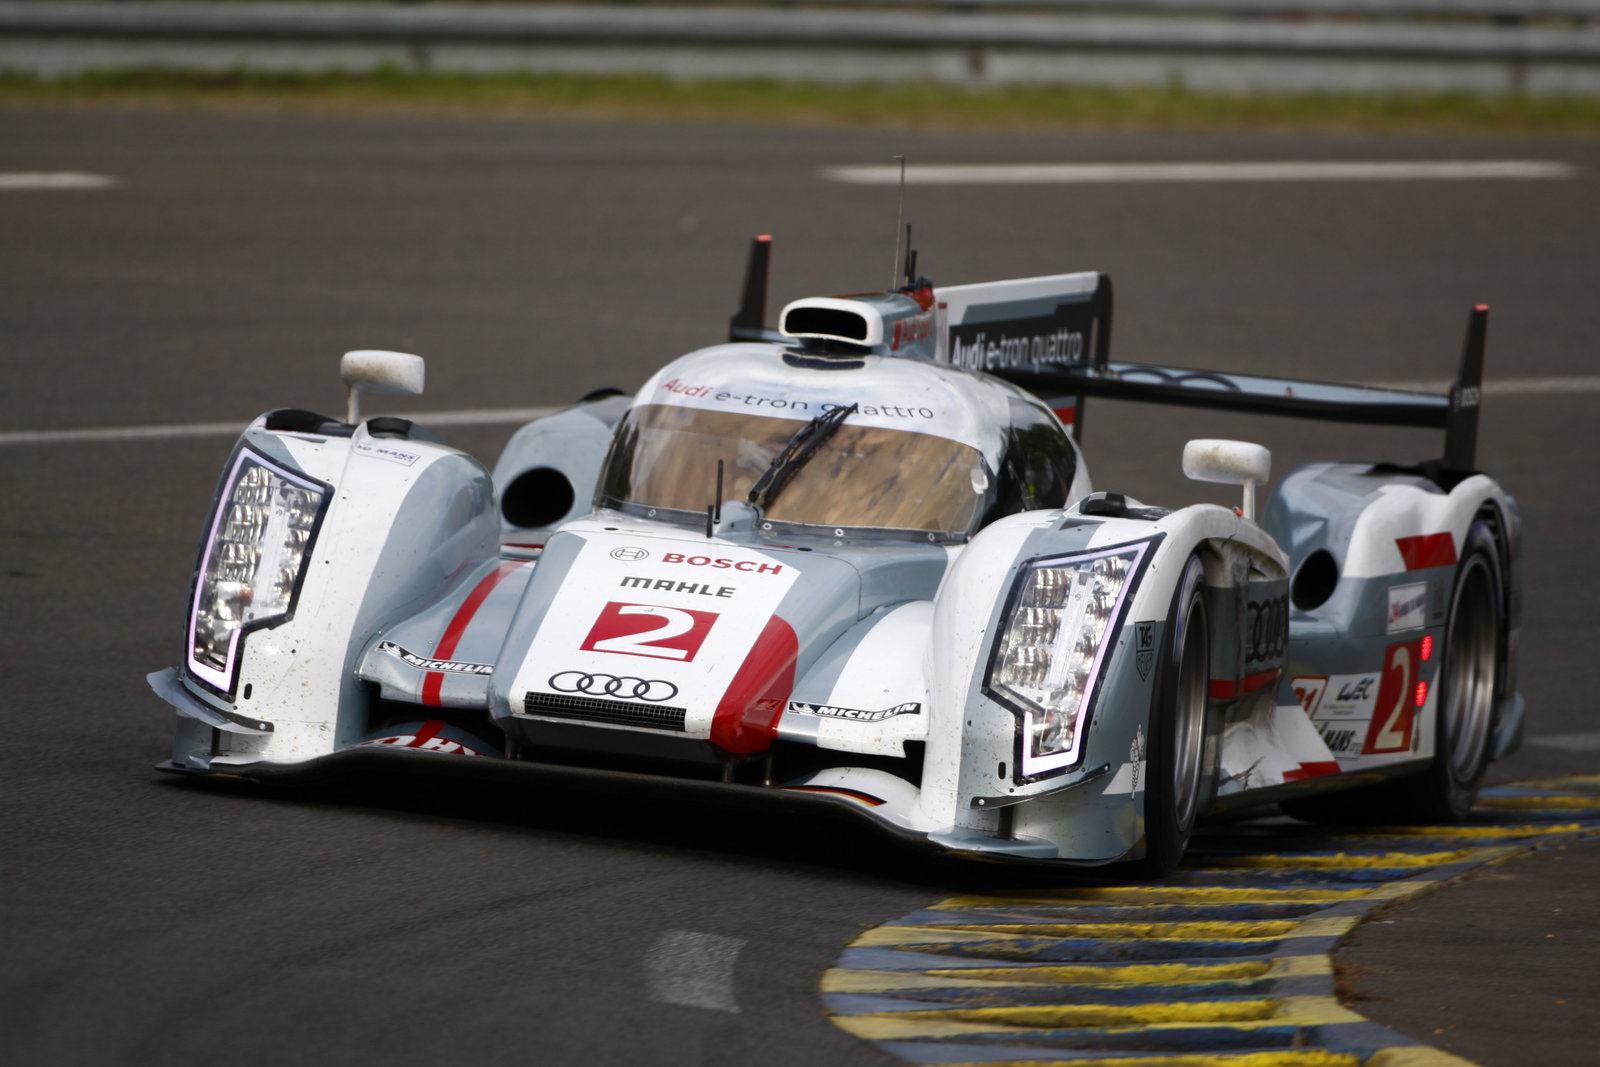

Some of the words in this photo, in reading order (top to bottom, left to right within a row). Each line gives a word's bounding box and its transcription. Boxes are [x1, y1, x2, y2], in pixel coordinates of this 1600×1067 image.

[952, 332, 985, 371] Audi
[985, 334, 1028, 371] e-tron
[1031, 328, 1083, 373] quattro
[662, 377, 713, 399] Audi
[715, 390, 809, 412] e-tron
[820, 402, 935, 421] qattro
[662, 552, 783, 576] BOSCH
[620, 576, 737, 599] MAHLE
[593, 605, 696, 660] 2
[403, 653, 494, 674] MICHELIN
[816, 702, 917, 721] MICHELIN
[1374, 646, 1411, 750] 2
